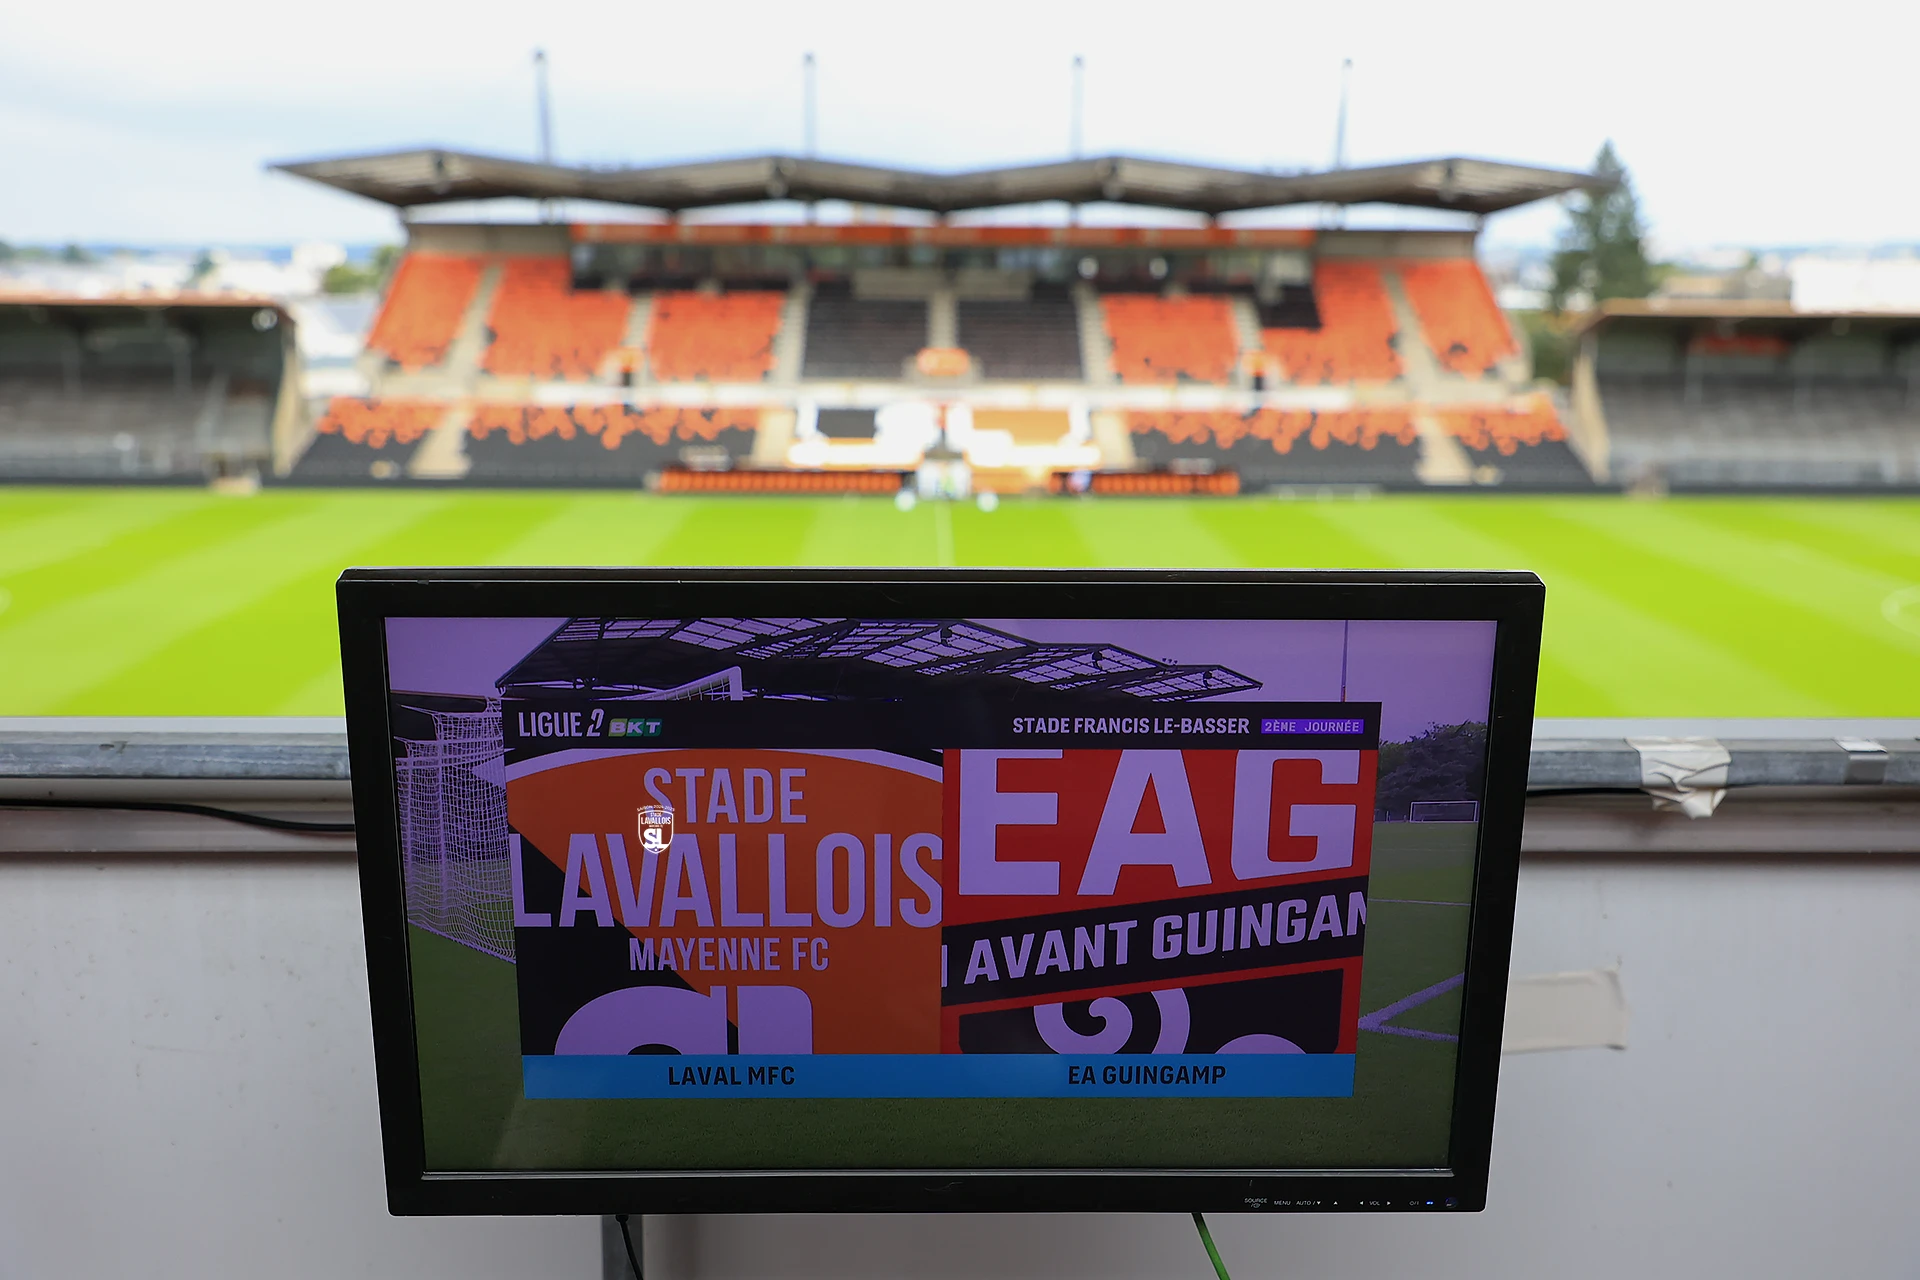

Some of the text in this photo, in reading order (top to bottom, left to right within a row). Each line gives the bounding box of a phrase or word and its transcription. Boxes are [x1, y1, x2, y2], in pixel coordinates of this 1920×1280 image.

[518, 708, 661, 737] LIGUE 2 BKT
[1012, 717, 1250, 734] STADE FRANCIS LE-BASSER
[1264, 720, 1360, 732] 2ÈME JOURNÉE
[643, 768, 807, 824] STADE
[959, 749, 1361, 896] EAG
[510, 832, 943, 929] LAVALLOIS
[629, 937, 829, 971] MAYENNE FC
[963, 919, 1138, 985] AVANT
[668, 1066, 796, 1086] LAVAL MFC
[1068, 1065, 1227, 1085] EA GUINGAMP
